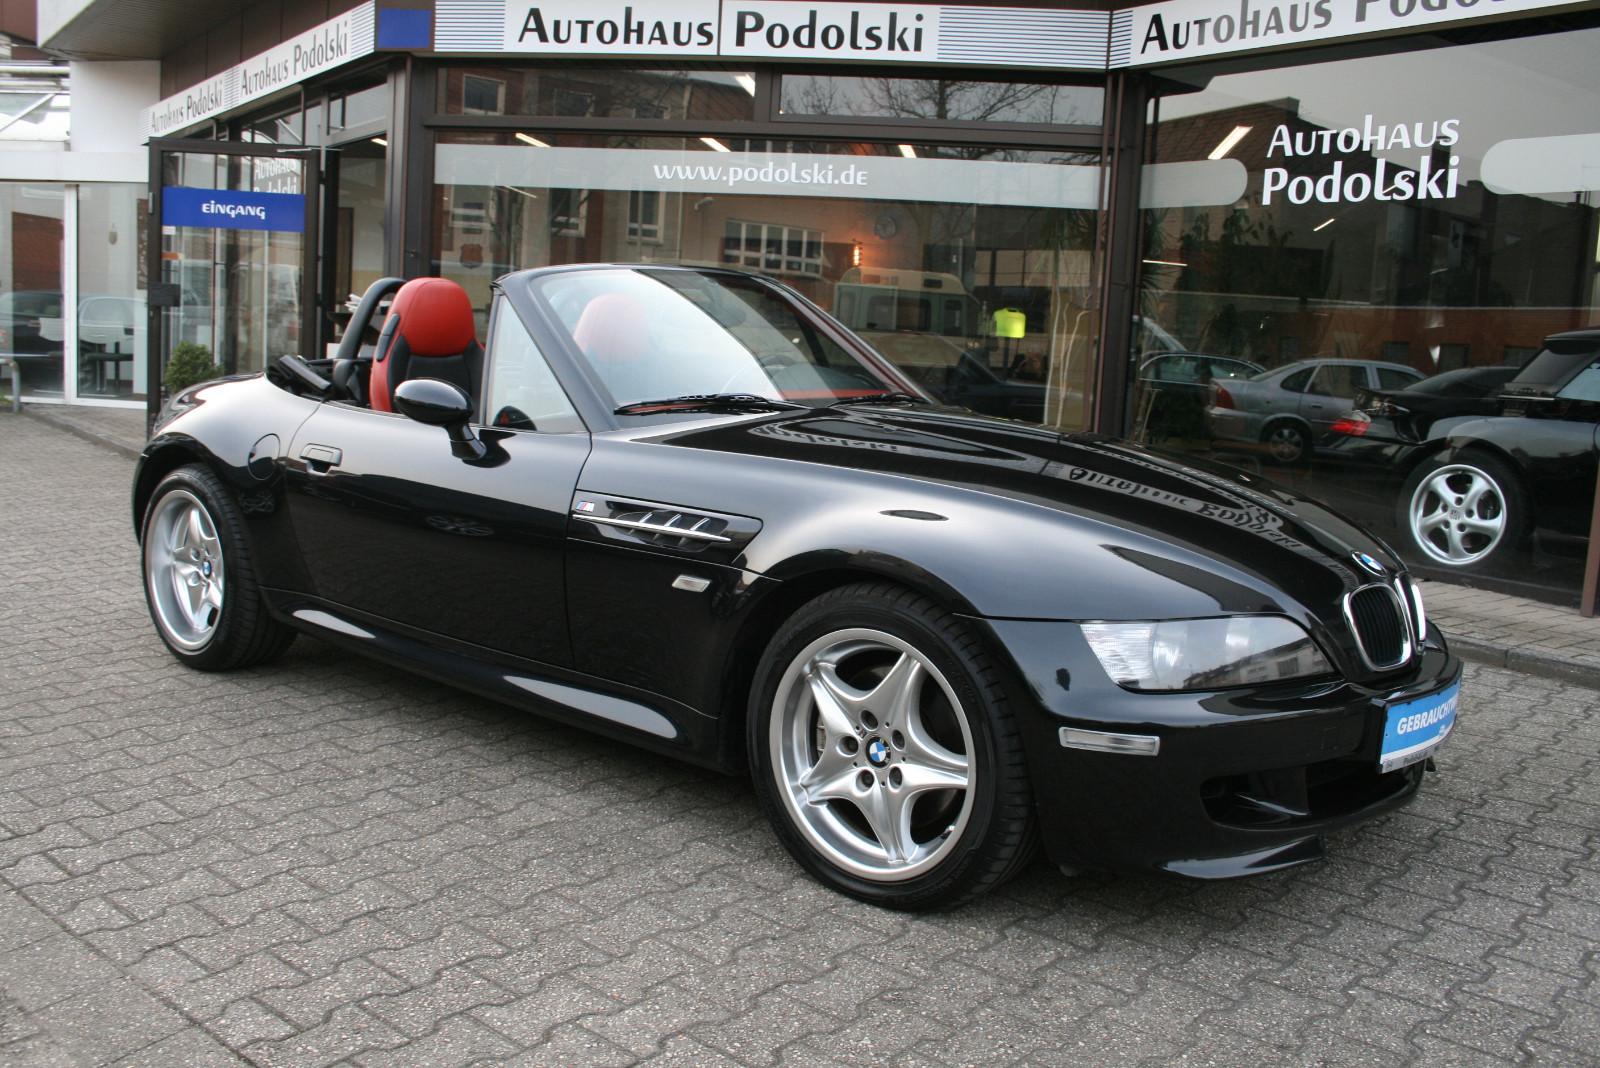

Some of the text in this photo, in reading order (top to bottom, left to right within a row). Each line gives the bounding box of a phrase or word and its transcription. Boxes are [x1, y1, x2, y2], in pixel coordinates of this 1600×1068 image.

[293, 20, 348, 76] Podolski
[735, 9, 924, 52] Podolski
[187, 80, 223, 120] Podolski
[653, 161, 868, 186] www.podolski.de
[1262, 155, 1460, 206] Podolski
